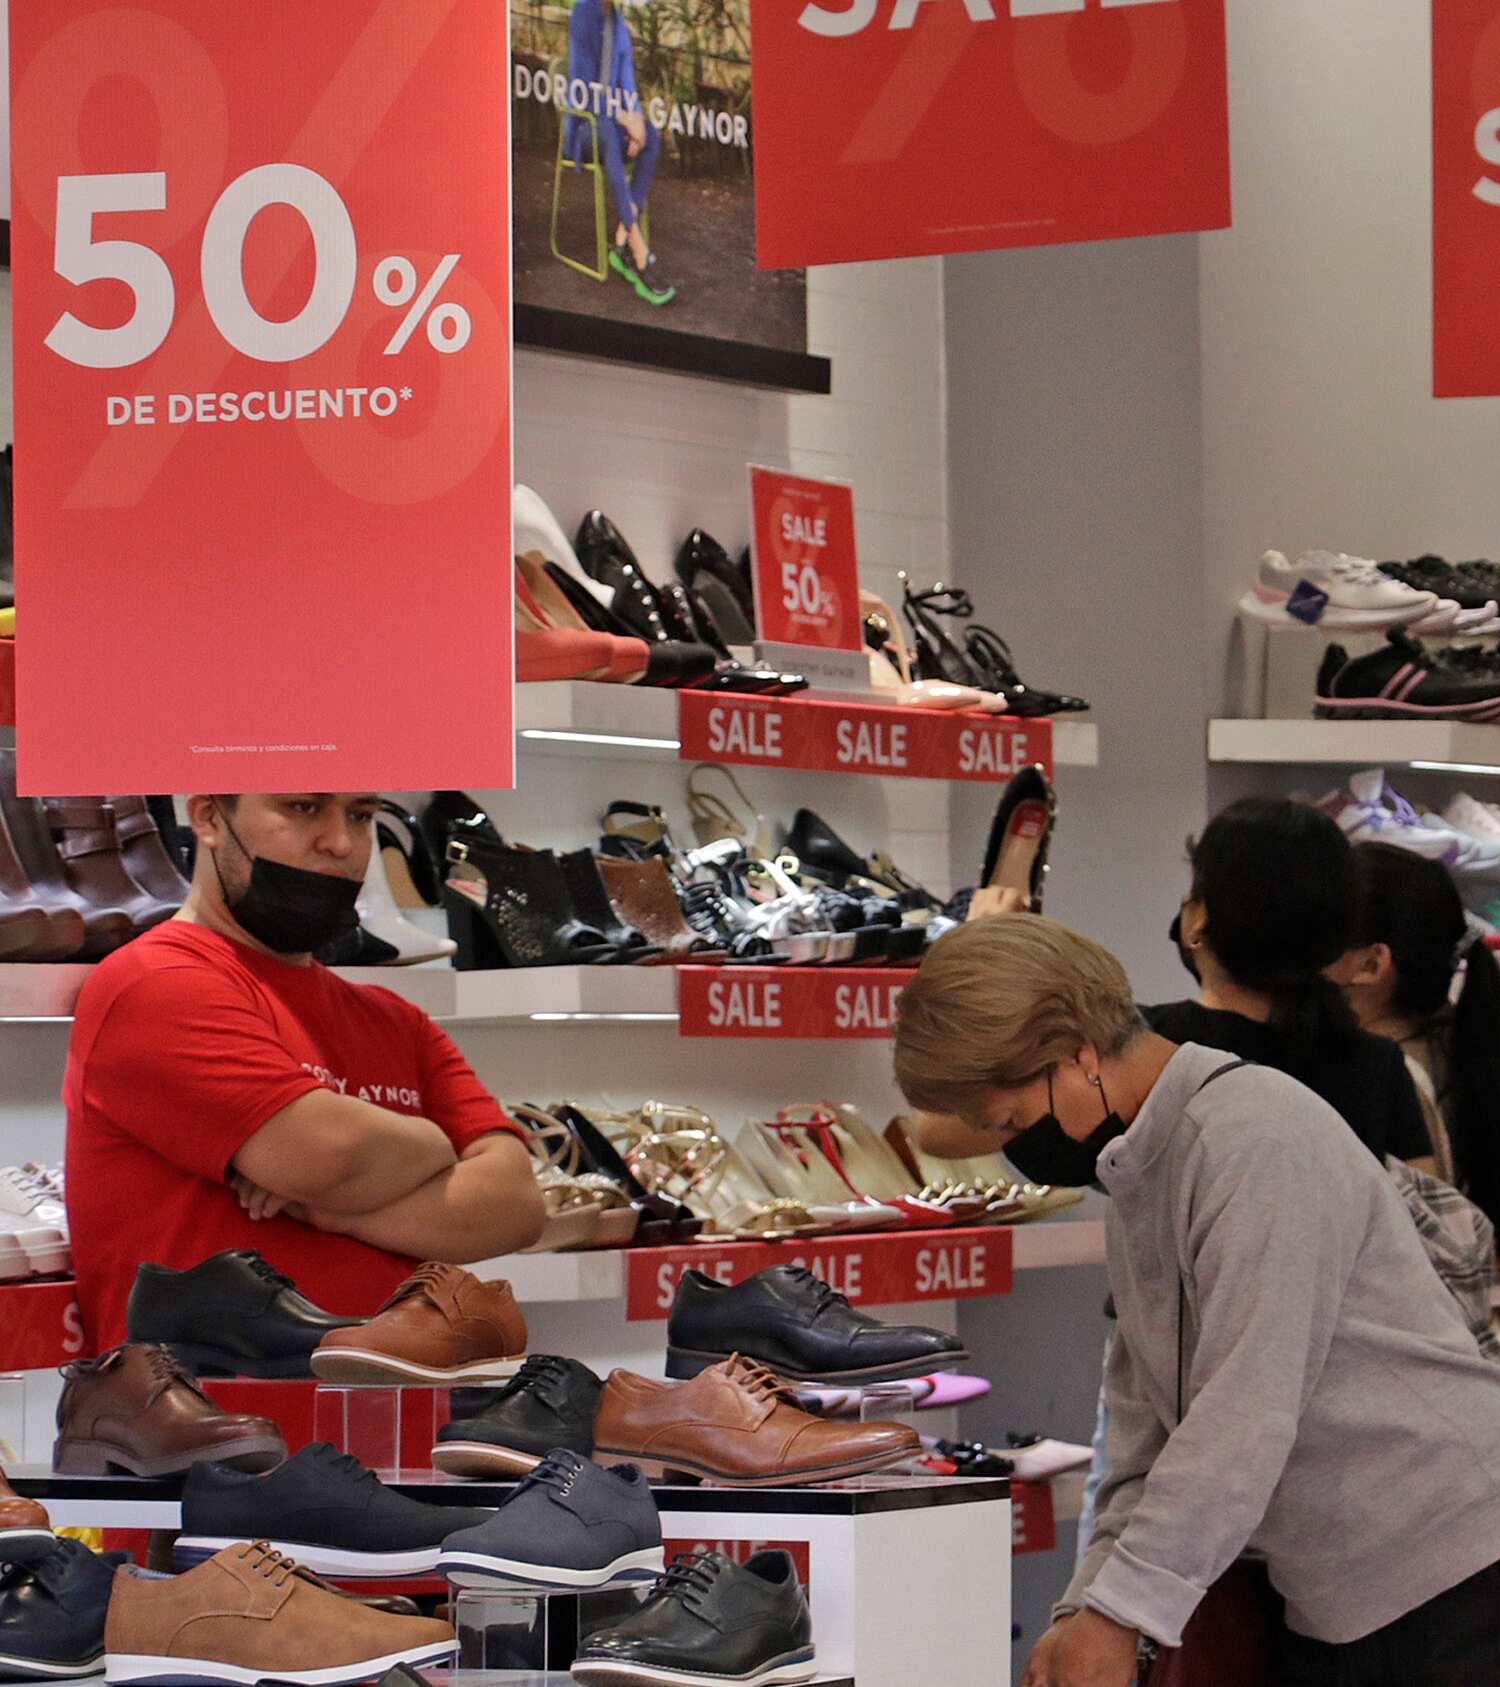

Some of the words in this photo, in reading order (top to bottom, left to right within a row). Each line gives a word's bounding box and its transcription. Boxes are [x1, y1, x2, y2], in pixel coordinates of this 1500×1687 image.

[514, 63, 639, 117] DOROTHY
[650, 96, 749, 149] GAYNOR
[43, 163, 472, 369] 50%
[106, 395, 155, 426] DE
[782, 512, 827, 547] SALE
[782, 562, 835, 616] 50%
[708, 707, 783, 757] SALE
[836, 720, 907, 767] SALE
[958, 730, 1027, 774] SALE
[708, 981, 782, 1027] SALE
[915, 1246, 986, 1292] SALE
